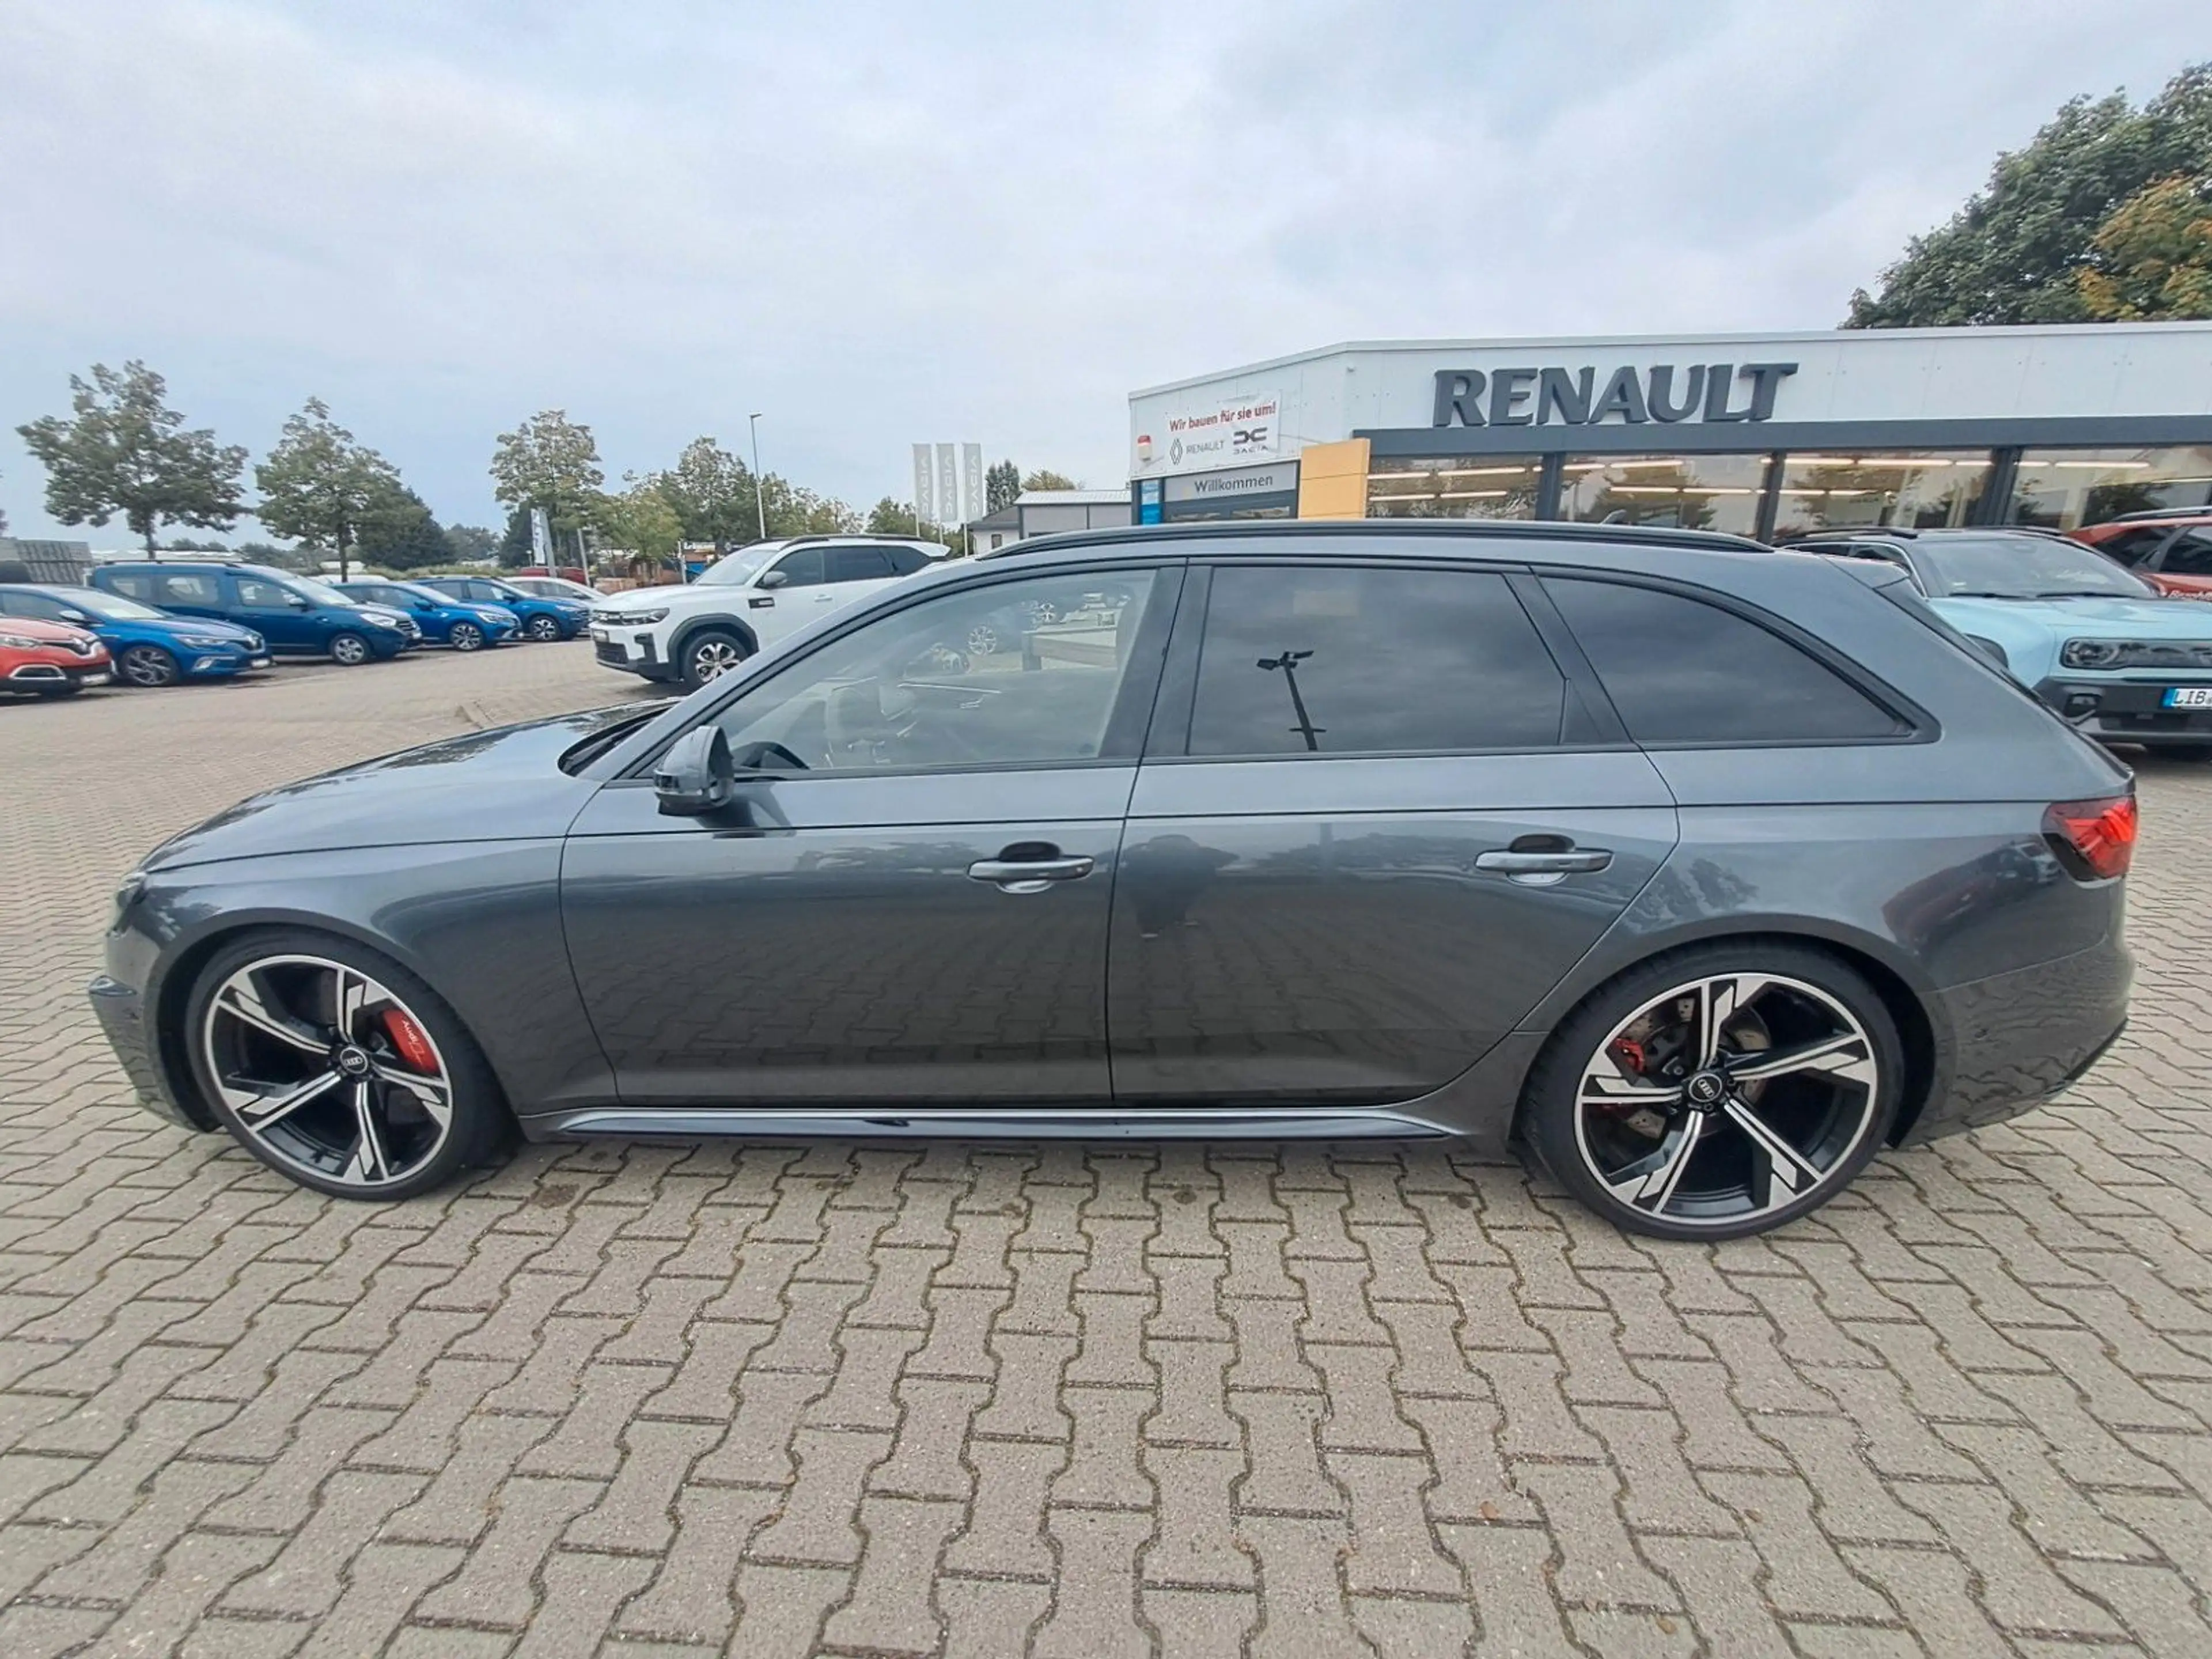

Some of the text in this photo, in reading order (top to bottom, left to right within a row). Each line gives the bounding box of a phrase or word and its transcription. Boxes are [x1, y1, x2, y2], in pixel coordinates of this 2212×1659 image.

[1433, 363, 1799, 428] RENAULT
[1169, 400, 1276, 432] Wir bauen für sie um!
[1186, 440, 1225, 454] RENAULT
[1233, 445, 1268, 455] DACIA
[1194, 476, 1272, 493] Willkommen
[2173, 691, 2207, 704] LIB
[402, 1020, 419, 1042] Audi
